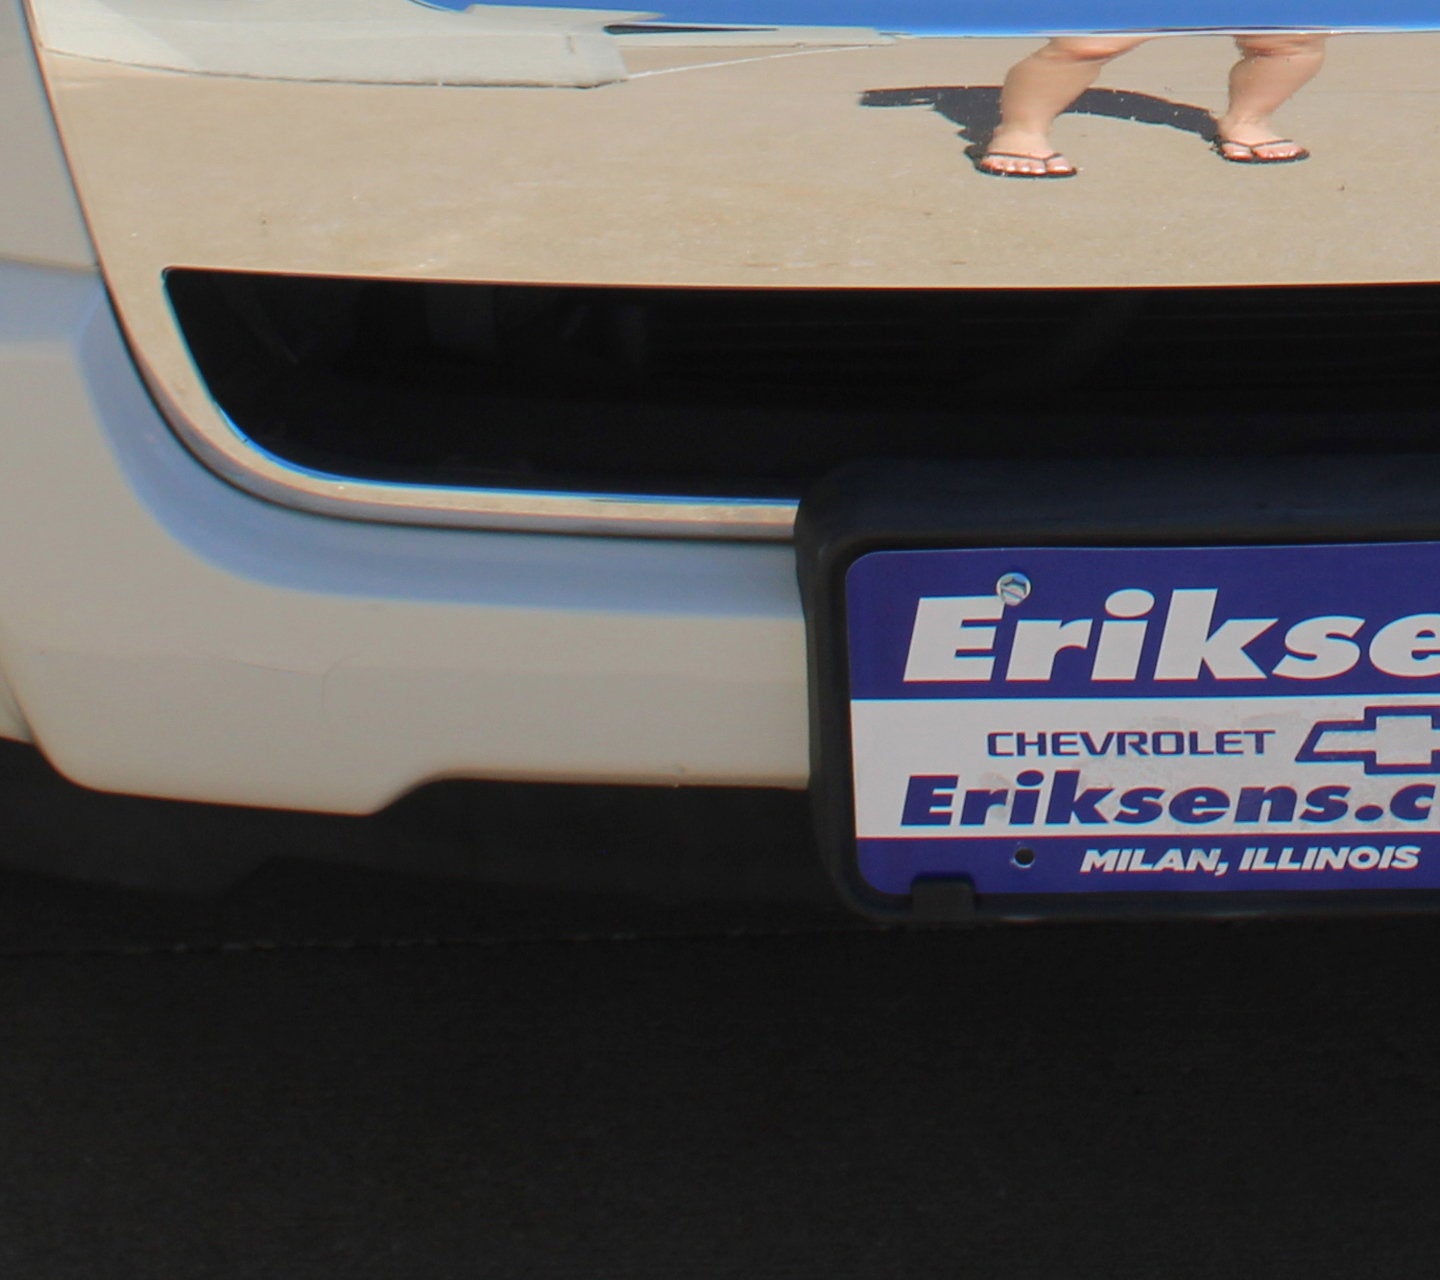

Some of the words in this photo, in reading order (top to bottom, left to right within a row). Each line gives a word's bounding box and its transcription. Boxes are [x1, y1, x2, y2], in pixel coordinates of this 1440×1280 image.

[986, 729, 1276, 758] CHEVROLET
[1080, 847, 1228, 877] MILAN,
[1238, 844, 1421, 873] ILLINOIS
